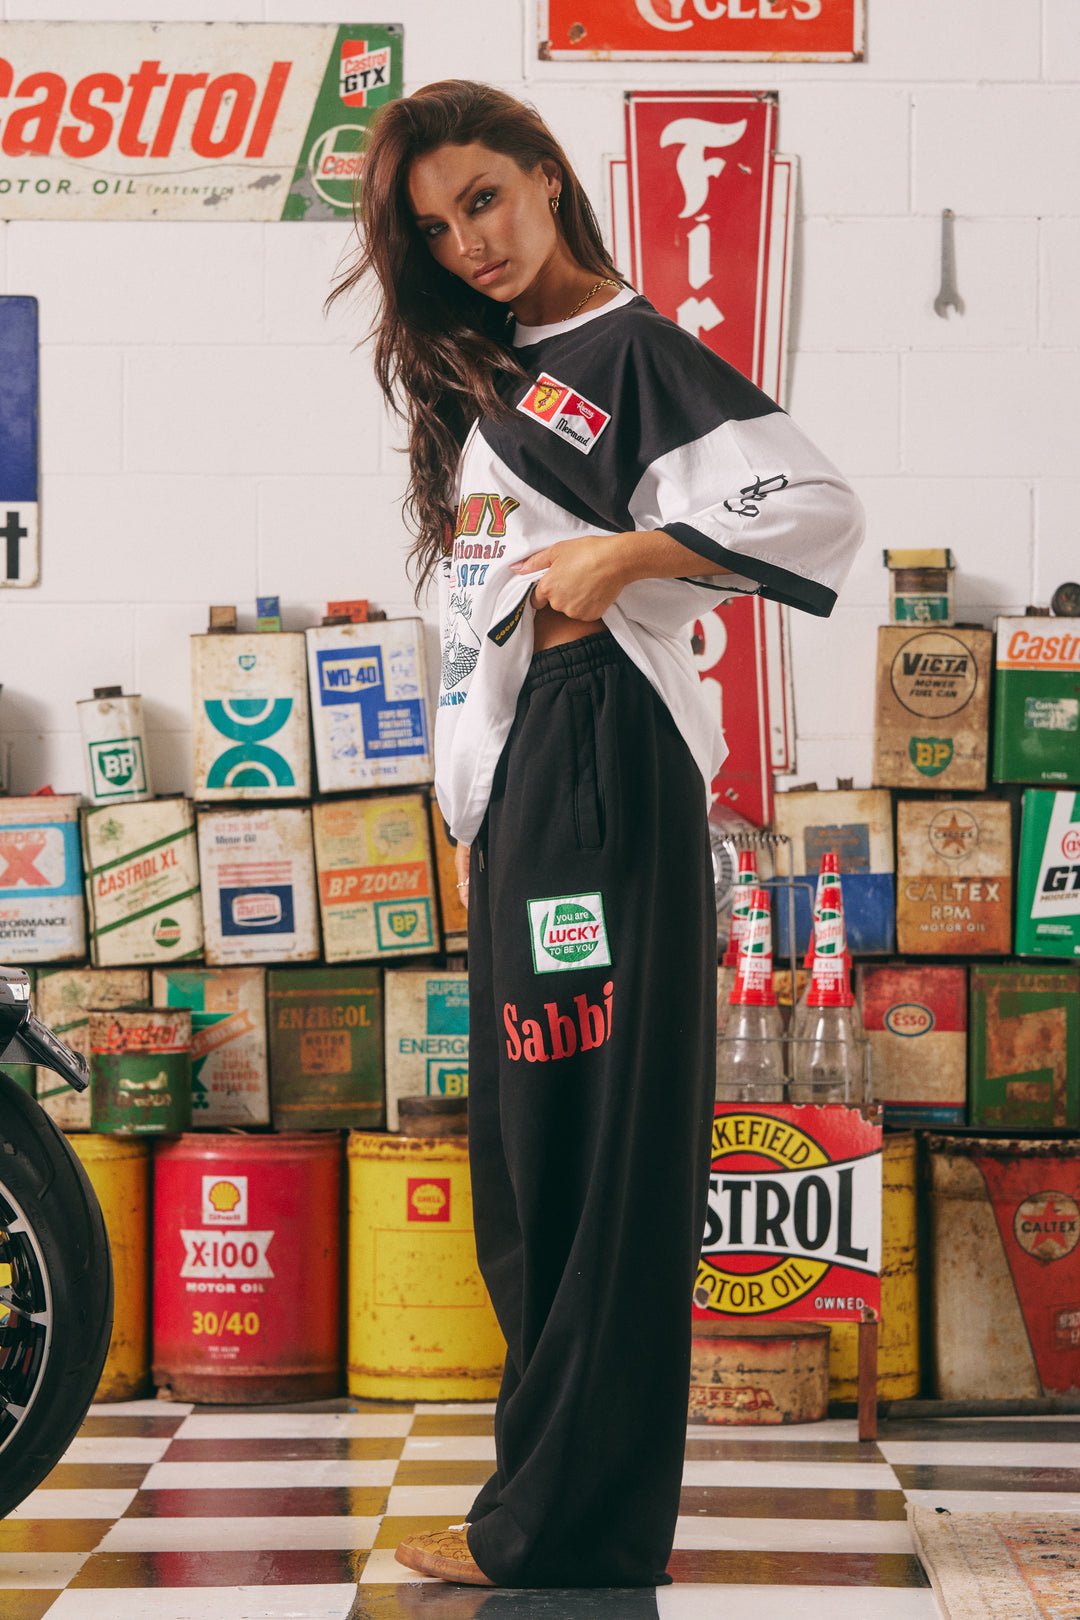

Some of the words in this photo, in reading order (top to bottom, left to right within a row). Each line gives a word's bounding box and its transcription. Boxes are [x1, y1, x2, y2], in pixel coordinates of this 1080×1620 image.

[345, 51, 387, 74] Castrol
[345, 66, 385, 93] GTX
[0, 60, 292, 158] astrol
[93, 179, 136, 194] OIL
[556, 418, 590, 446] Mermaid
[457, 564, 489, 587] 1977
[903, 652, 968, 676] VICTA
[326, 665, 377, 687] WD-40
[914, 680, 955, 688] MOWER
[910, 689, 932, 698] FUEL
[937, 689, 957, 698] CAN
[103, 753, 134, 778] BP
[916, 742, 950, 768] BP
[934, 831, 973, 840] CALTEX
[98, 857, 158, 896] CASTROL
[160, 848, 178, 870] XL
[328, 876, 360, 898] BP
[361, 869, 421, 895] ZOOM
[905, 883, 1001, 902] CALTEX
[392, 914, 417, 932] BP
[556, 914, 573, 924] you
[575, 911, 589, 920] are
[931, 905, 971, 920] RPM
[549, 925, 599, 944] LUCKY
[919, 923, 961, 933] MOTOR
[966, 923, 985, 933] OIL
[550, 947, 561, 956] TO
[563, 945, 575, 954] BE
[576, 943, 594, 953] YOU
[278, 1005, 371, 1030] ENERGOL
[107, 1023, 179, 1046] Castrol
[399, 1039, 468, 1054] ENERG
[1021, 1220, 1076, 1234] CALTEX
[191, 1241, 259, 1268] X-100
[186, 1282, 236, 1293] MOTOR
[241, 1282, 265, 1293] OIL
[771, 1263, 812, 1298] OIL
[814, 1296, 865, 1310] OWNED
[192, 1310, 260, 1337] 30/40
